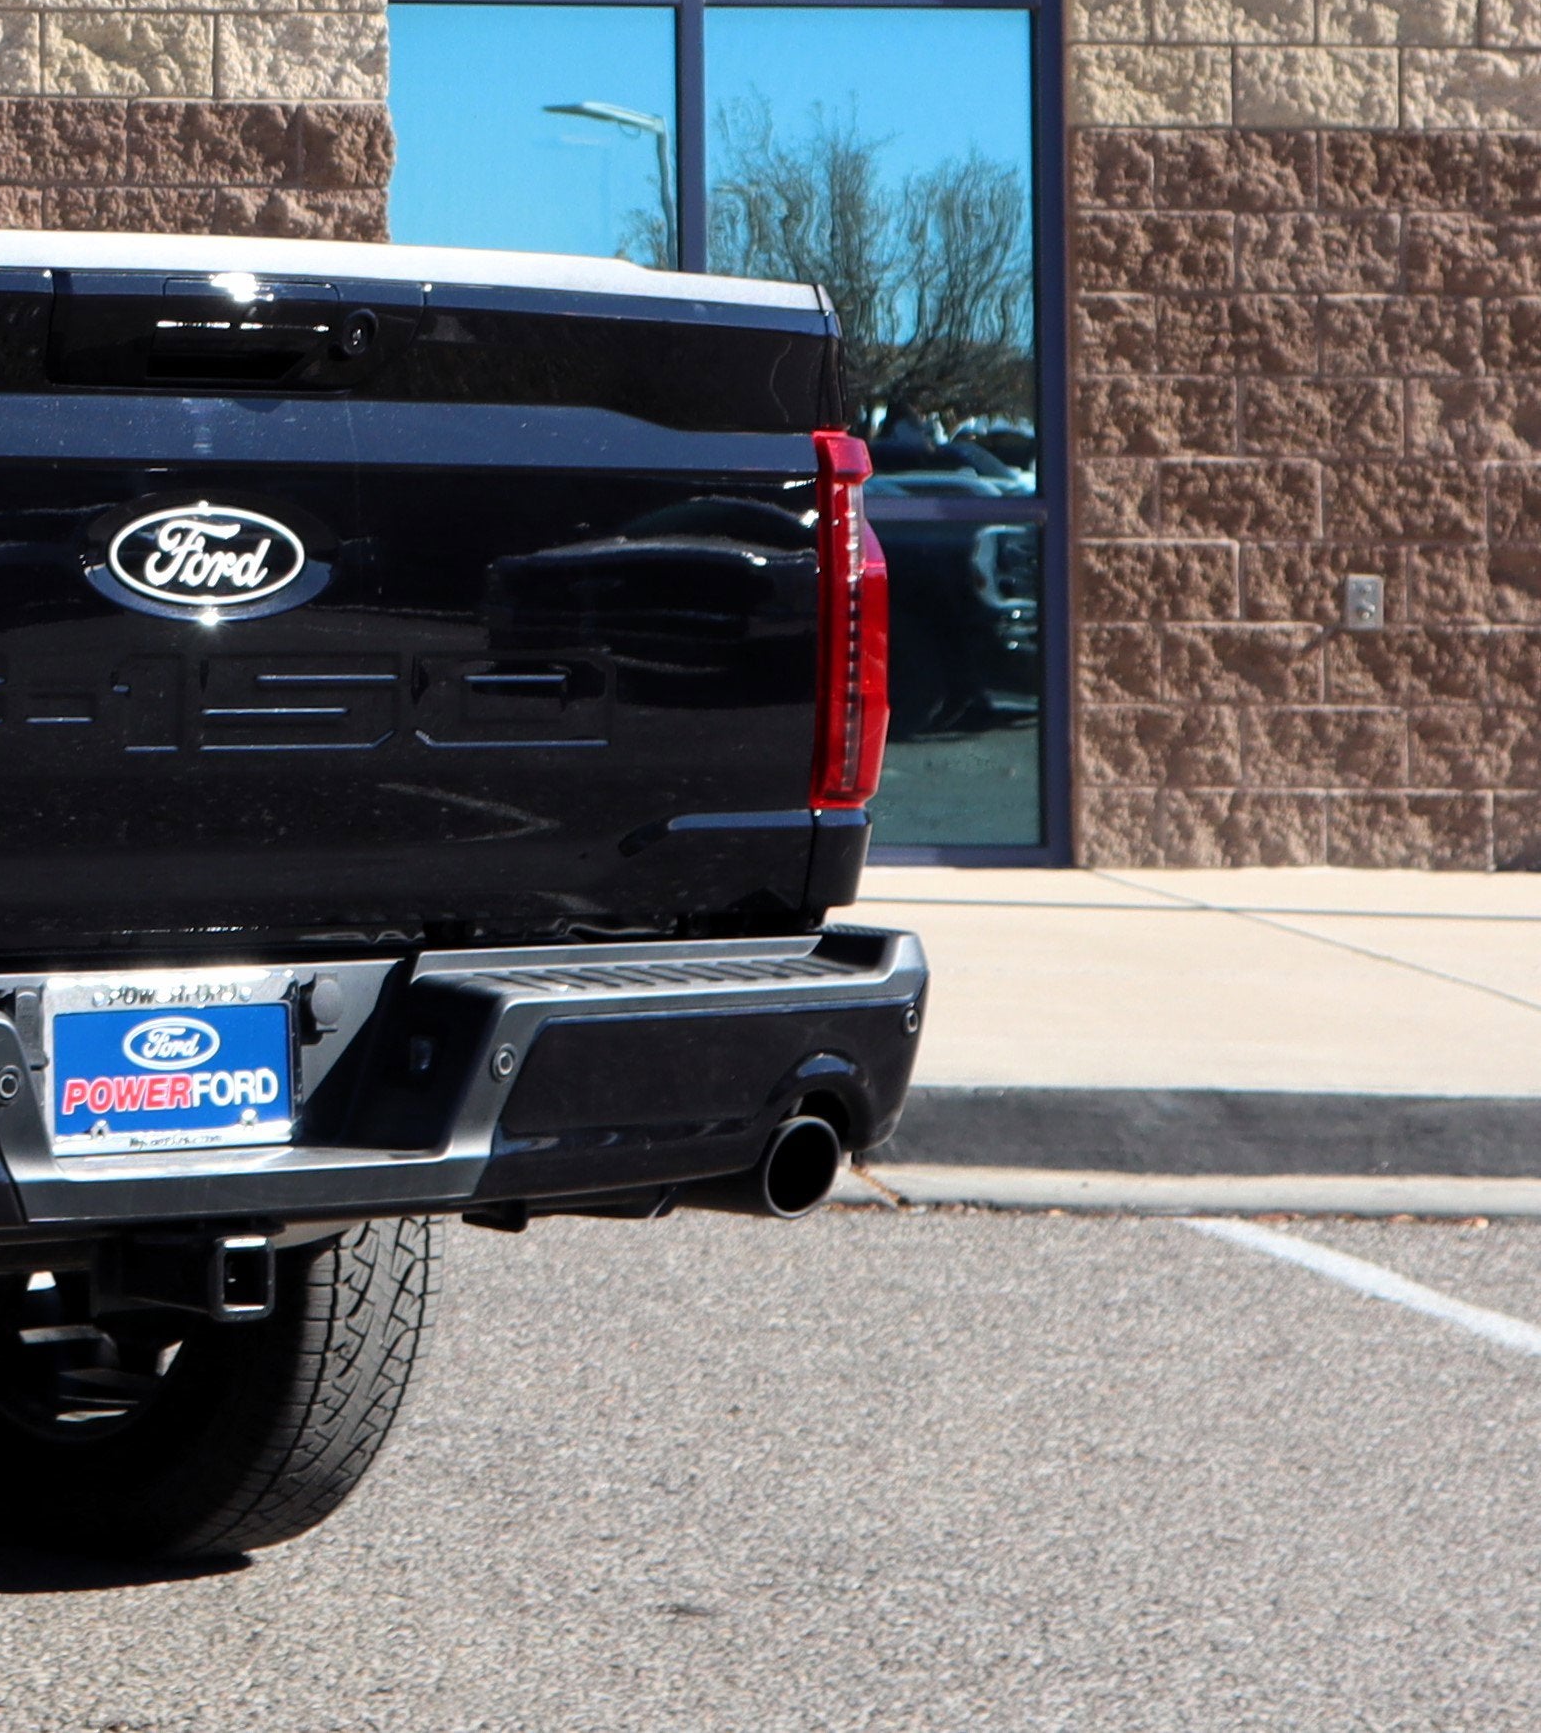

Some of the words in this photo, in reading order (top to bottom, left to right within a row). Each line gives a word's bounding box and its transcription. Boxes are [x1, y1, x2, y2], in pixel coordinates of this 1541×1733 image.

[144, 519, 272, 588] Ford
[142, 1027, 201, 1059] Ford
[62, 1067, 279, 1115] POWERFORD
